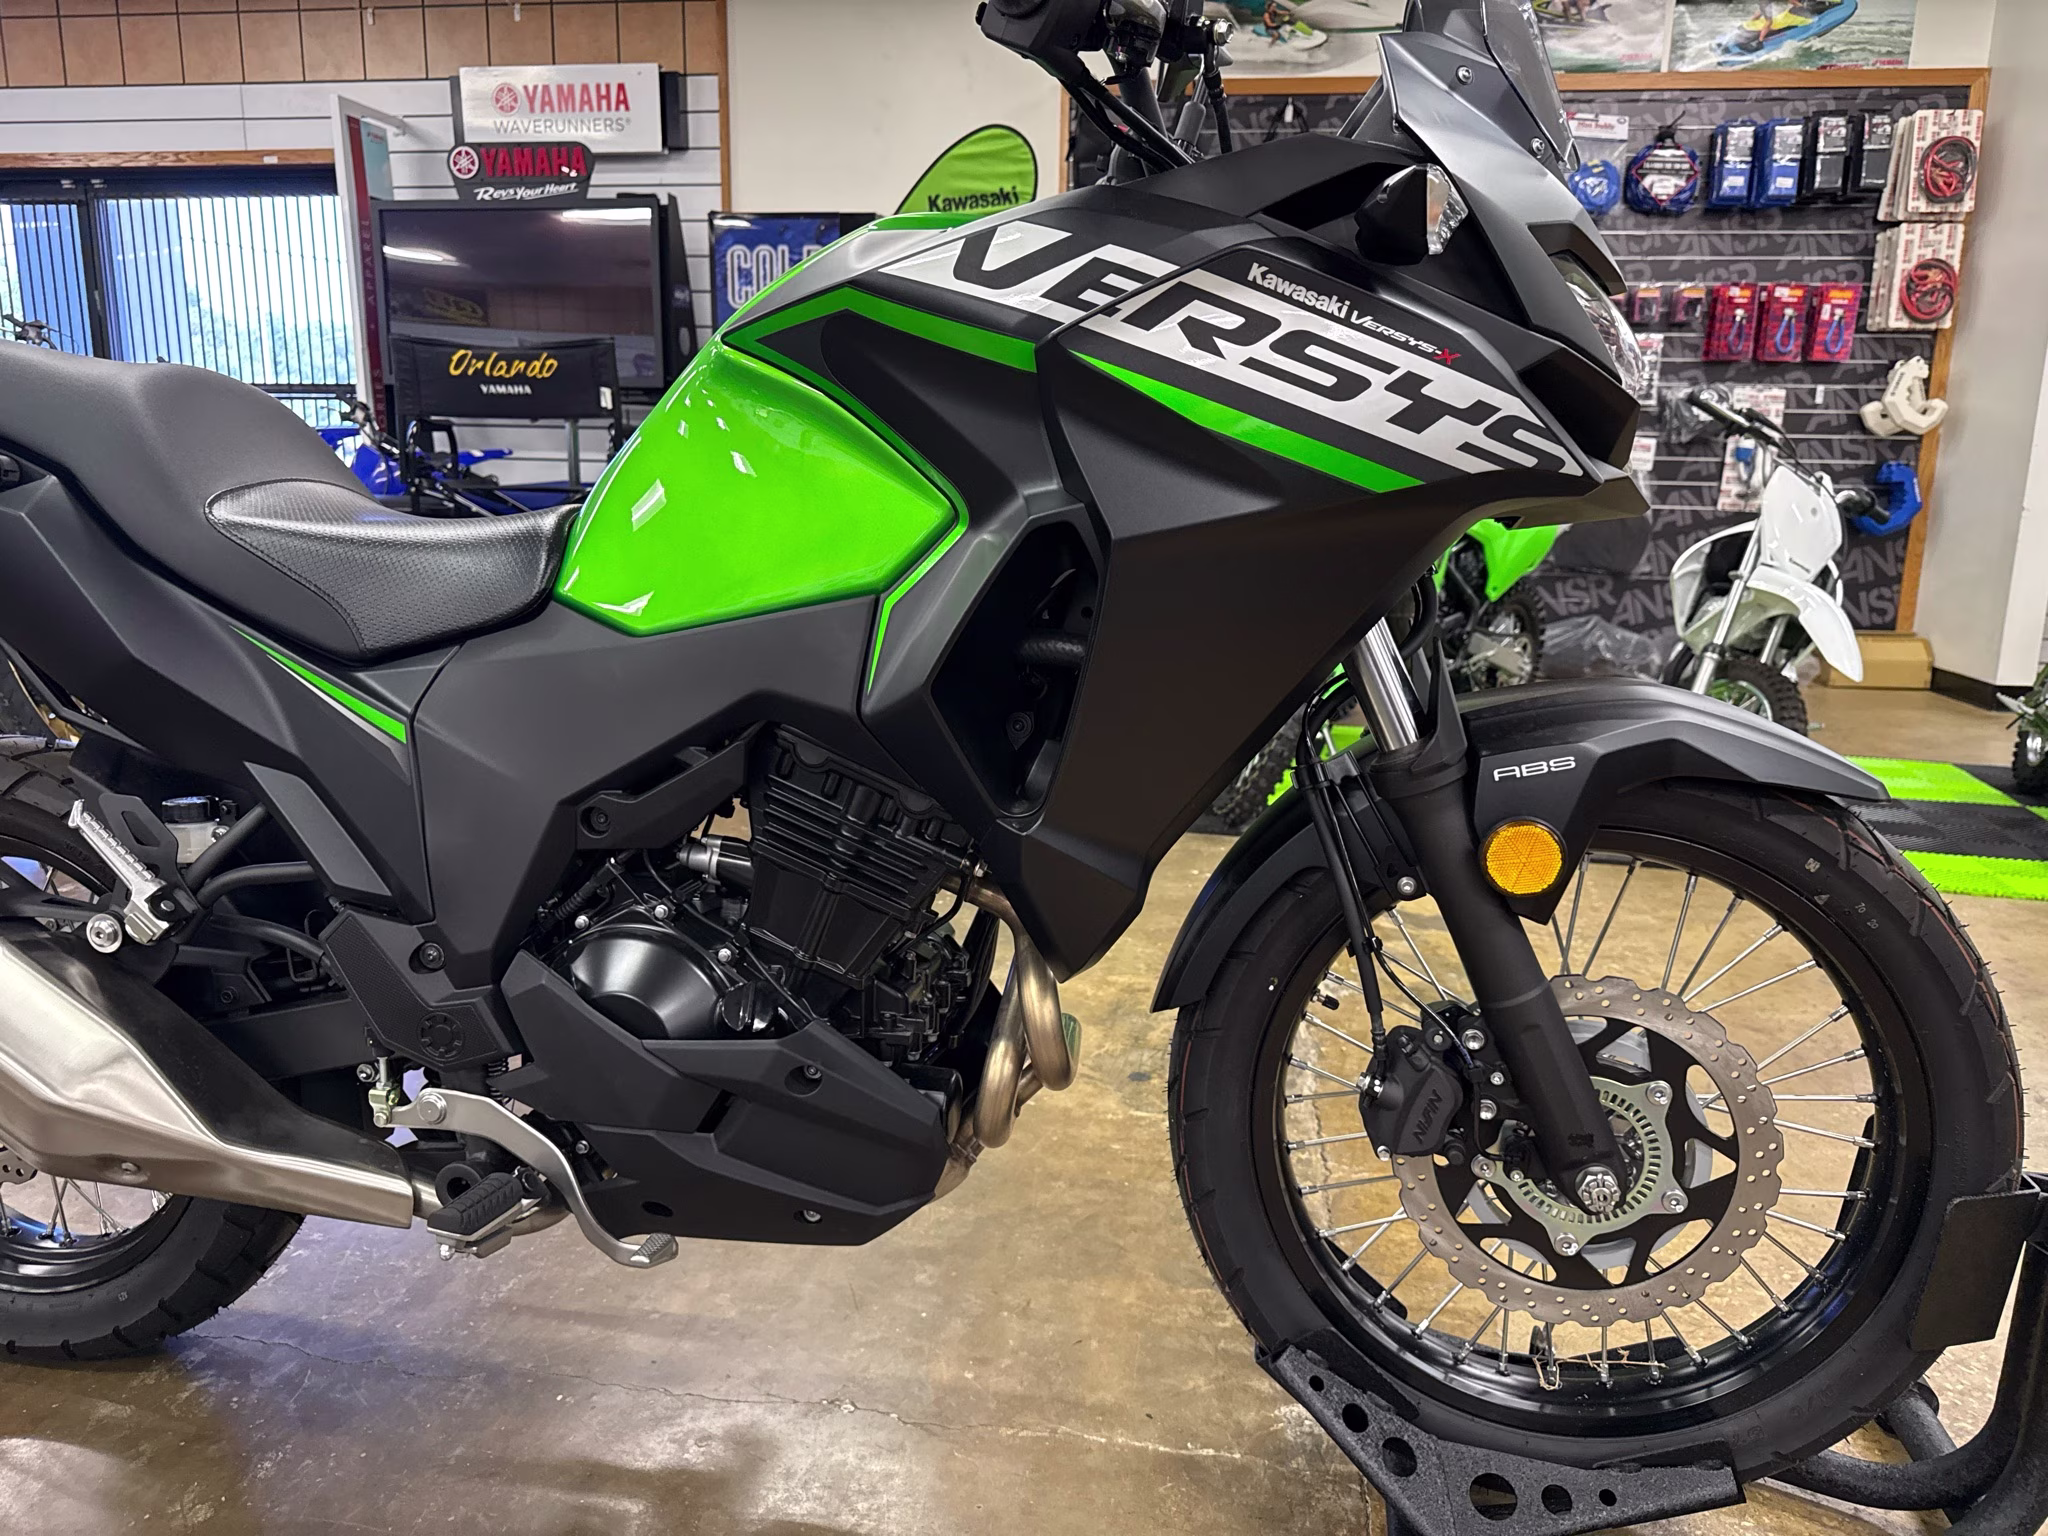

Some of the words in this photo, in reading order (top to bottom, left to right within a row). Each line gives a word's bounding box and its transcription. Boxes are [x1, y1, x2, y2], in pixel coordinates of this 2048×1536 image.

[523, 82, 630, 114] YAMAHA
[493, 117, 626, 134] WAVERUNNERS
[481, 146, 588, 178] YAMAHA
[473, 186, 515, 201] Revs
[543, 182, 577, 195] Heart
[927, 186, 1020, 213] Kawasaki
[1247, 262, 1351, 320] Kawasaki
[1349, 309, 1461, 366] VERSYS-X
[953, 222, 1568, 472] VERSYS
[448, 349, 558, 379] Orlando
[479, 384, 533, 395] YAMAHA
[1493, 756, 1576, 782] ABS
